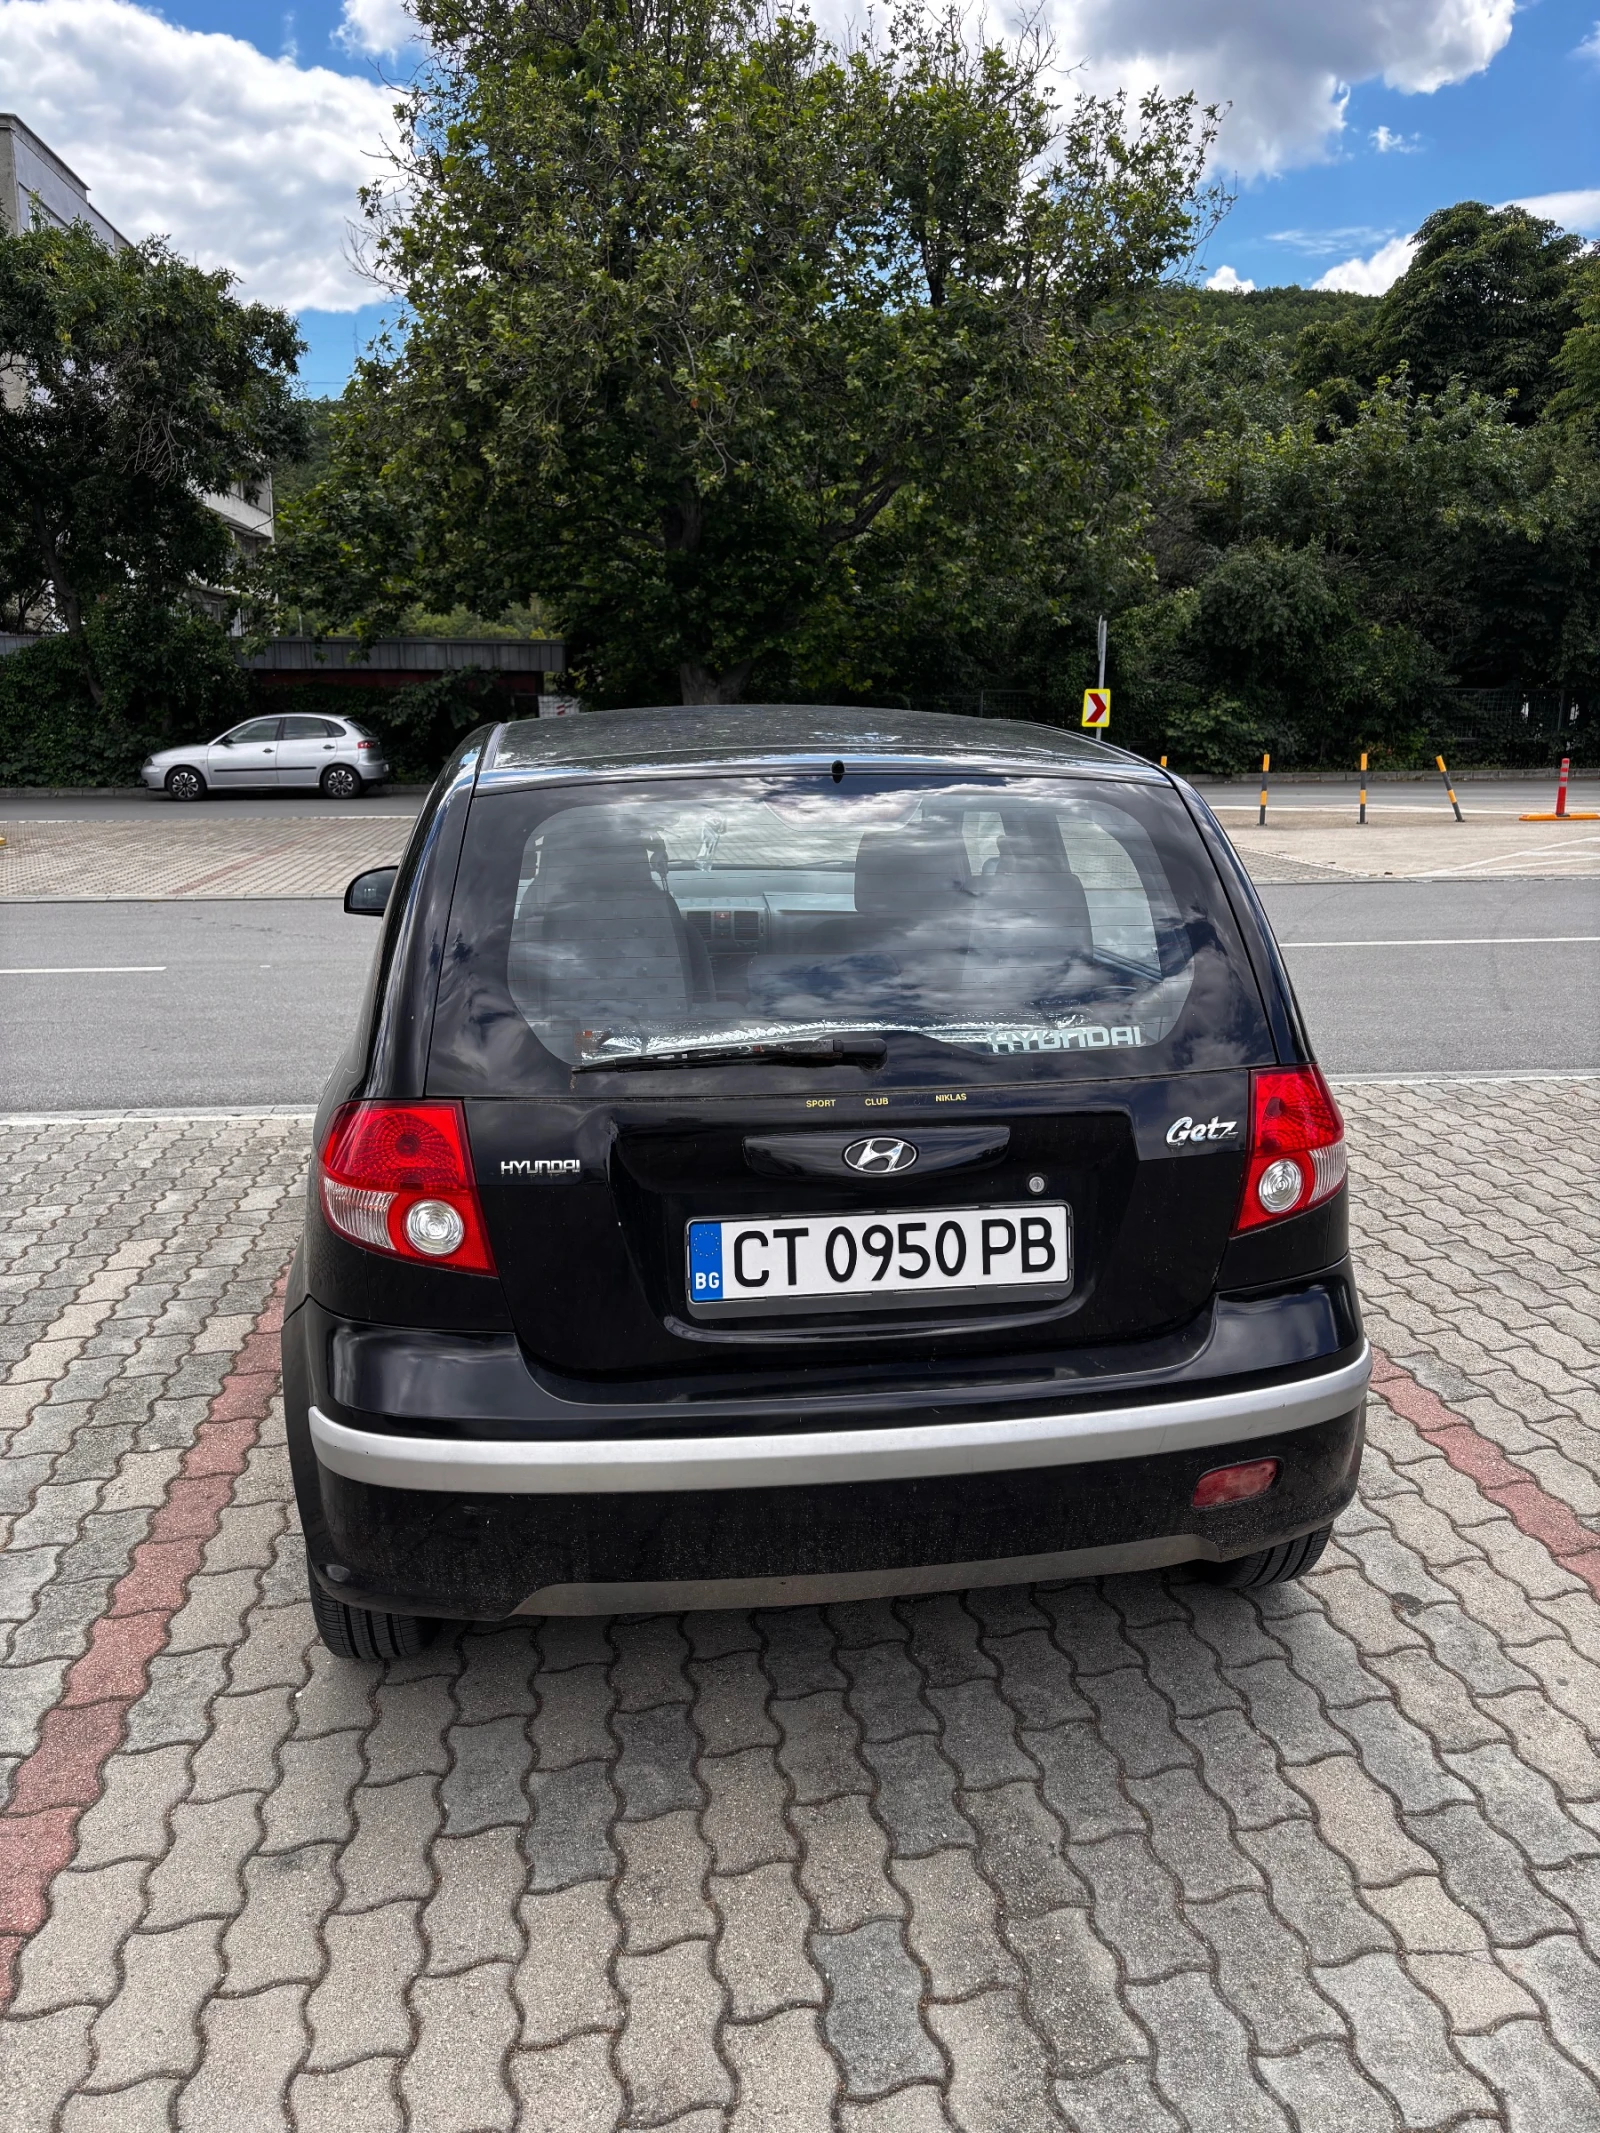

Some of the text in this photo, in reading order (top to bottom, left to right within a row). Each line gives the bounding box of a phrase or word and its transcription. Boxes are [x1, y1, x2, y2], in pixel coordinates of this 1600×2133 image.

[989, 1026, 1141, 1053] HYUNDAI
[806, 1093, 967, 1108] SPORT CLUB NIKLAS
[1166, 1116, 1238, 1146] Getz
[501, 1160, 580, 1174] HYUNDAI
[733, 1217, 1056, 1288] CT 0950 PB
[695, 1272, 720, 1289] BG
